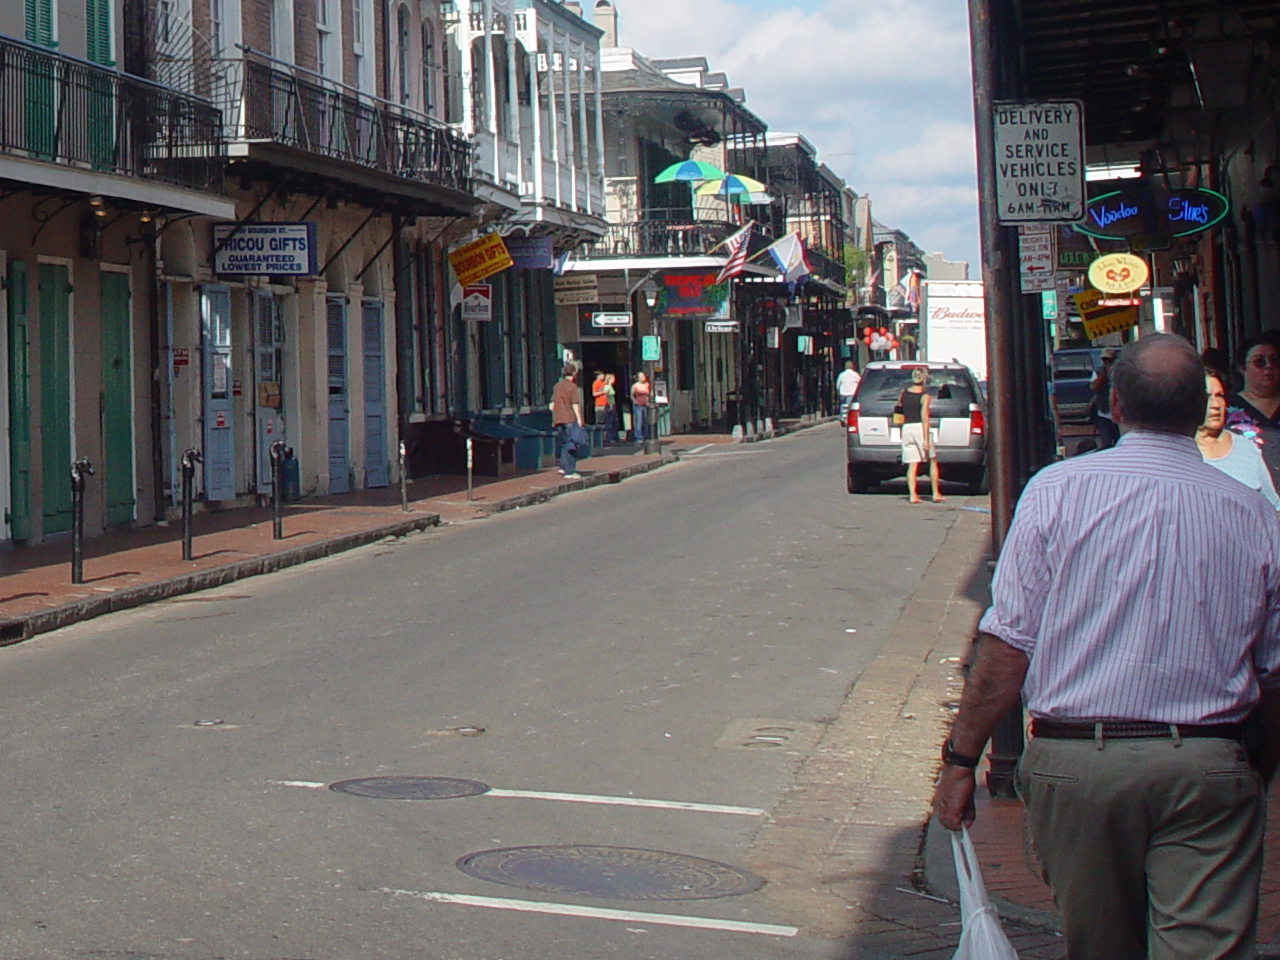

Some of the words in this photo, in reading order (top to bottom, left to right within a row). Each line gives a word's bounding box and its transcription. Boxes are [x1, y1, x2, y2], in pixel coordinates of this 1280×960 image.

[999, 109, 1072, 125] DELIVERY
[1024, 128, 1049, 141] AND
[1005, 143, 1069, 158] SERVICE
[999, 161, 1077, 178] VEHICLES
[1090, 202, 1138, 229] Voodoo
[269, 237, 306, 252] GIFTS
[228, 254, 295, 263] GUARANTEED
[221, 263, 262, 272] LOWEST
[265, 262, 302, 272] PRICES
